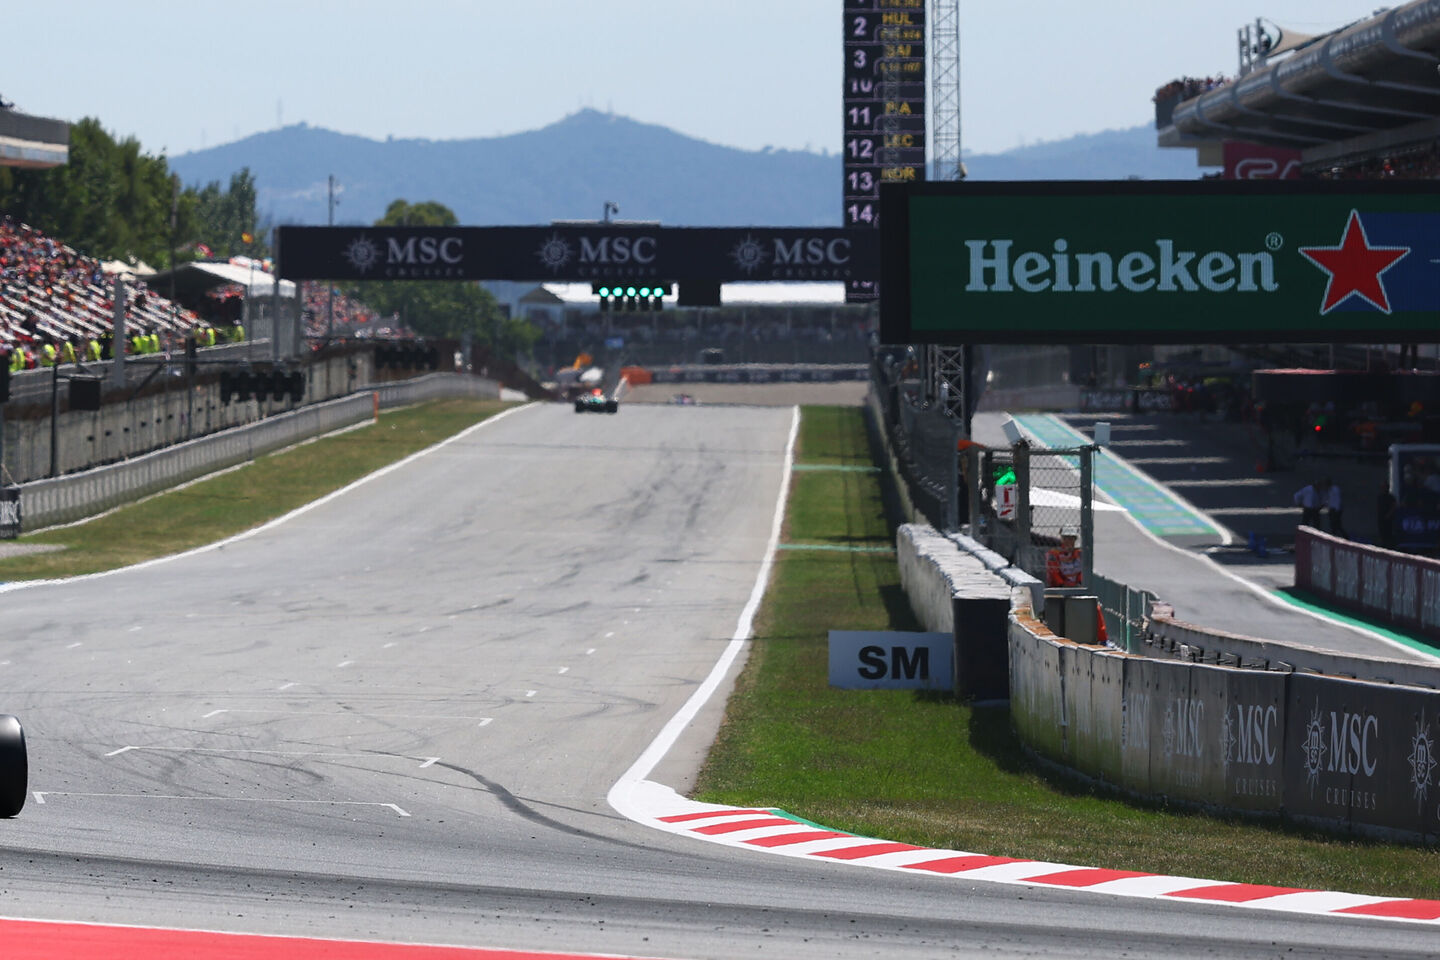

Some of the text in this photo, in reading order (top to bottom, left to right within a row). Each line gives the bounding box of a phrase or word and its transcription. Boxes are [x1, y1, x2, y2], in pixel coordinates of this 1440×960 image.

[854, 16, 867, 36] 2
[882, 12, 913, 25] HUL
[854, 50, 866, 68] 3
[848, 107, 870, 125] 11
[848, 139, 873, 158] 12
[848, 172, 873, 190] 13
[848, 204, 873, 223] 14
[386, 237, 463, 264] MSC
[579, 237, 657, 263] MSC
[773, 238, 851, 264] MSC
[857, 645, 929, 680] SM
[1176, 698, 1204, 758] MSC
[1237, 704, 1277, 765] MSC
[1327, 711, 1378, 777] MSC
[1235, 777, 1277, 797] CRUISES
[1326, 787, 1376, 810] CRUISES
